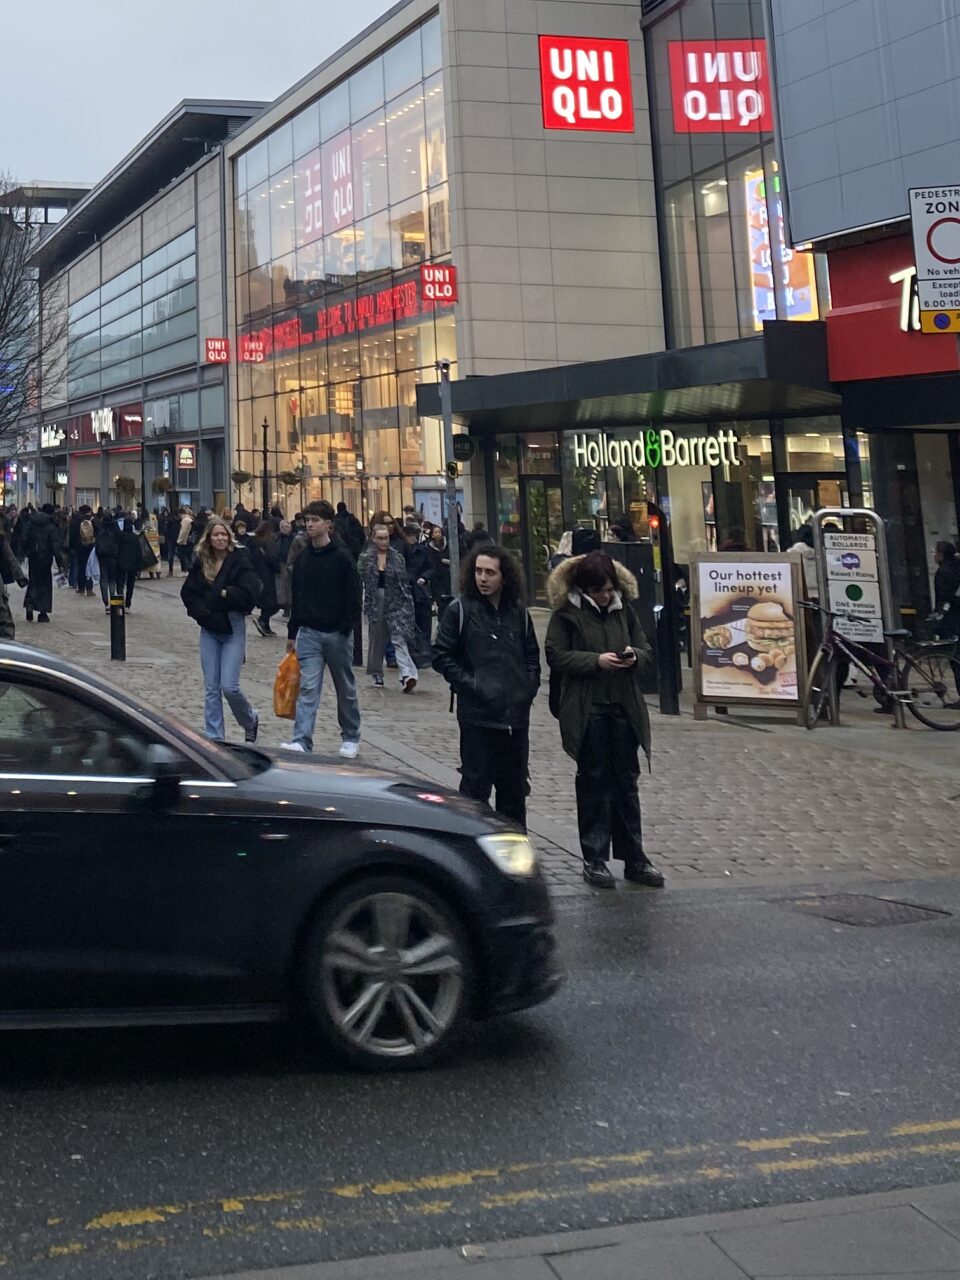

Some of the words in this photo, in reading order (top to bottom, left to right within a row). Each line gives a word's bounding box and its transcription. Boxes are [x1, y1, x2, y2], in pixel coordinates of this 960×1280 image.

[549, 48, 615, 82] UNI
[551, 85, 623, 124] QLO
[332, 145, 350, 182] UNI
[915, 189, 960, 199] PEDESTR
[333, 182, 353, 224] QLO
[925, 201, 959, 214] ZON
[424, 269, 450, 282] UNI
[927, 268, 941, 276] No
[425, 284, 453, 298] QLO
[932, 281, 960, 290] Excep
[208, 341, 225, 349] UNI
[208, 351, 227, 360] QLO
[709, 570, 733, 581] Our
[736, 570, 783, 581] hottest
[714, 582, 754, 595] lineup
[758, 584, 777, 596] yet
